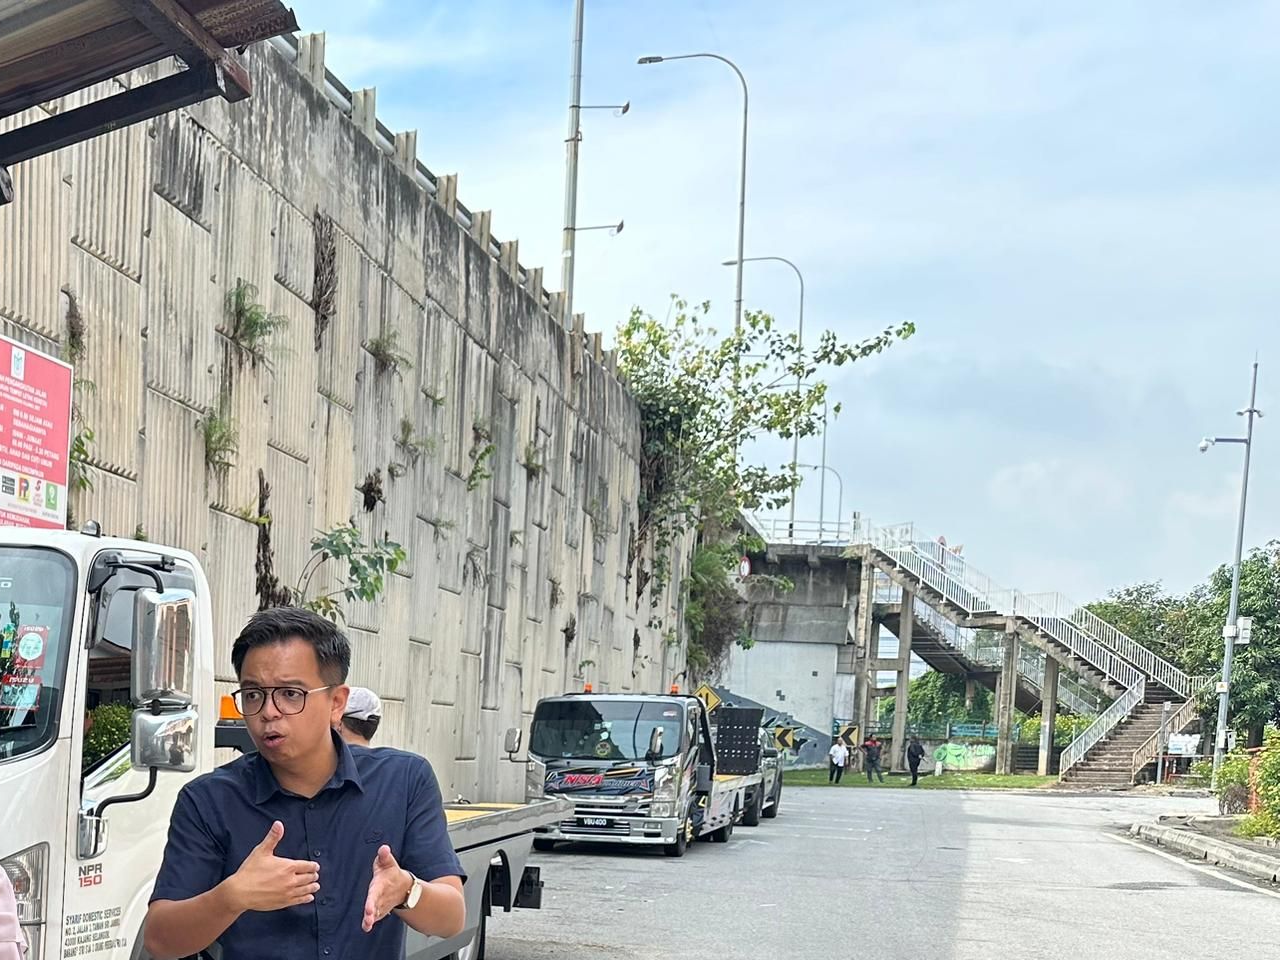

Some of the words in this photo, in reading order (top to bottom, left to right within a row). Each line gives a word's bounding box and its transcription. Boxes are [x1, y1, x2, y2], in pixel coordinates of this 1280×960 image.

[78, 863, 102, 876] NPR
[78, 874, 102, 887] 150
[82, 910, 103, 923] DOMESTIC
